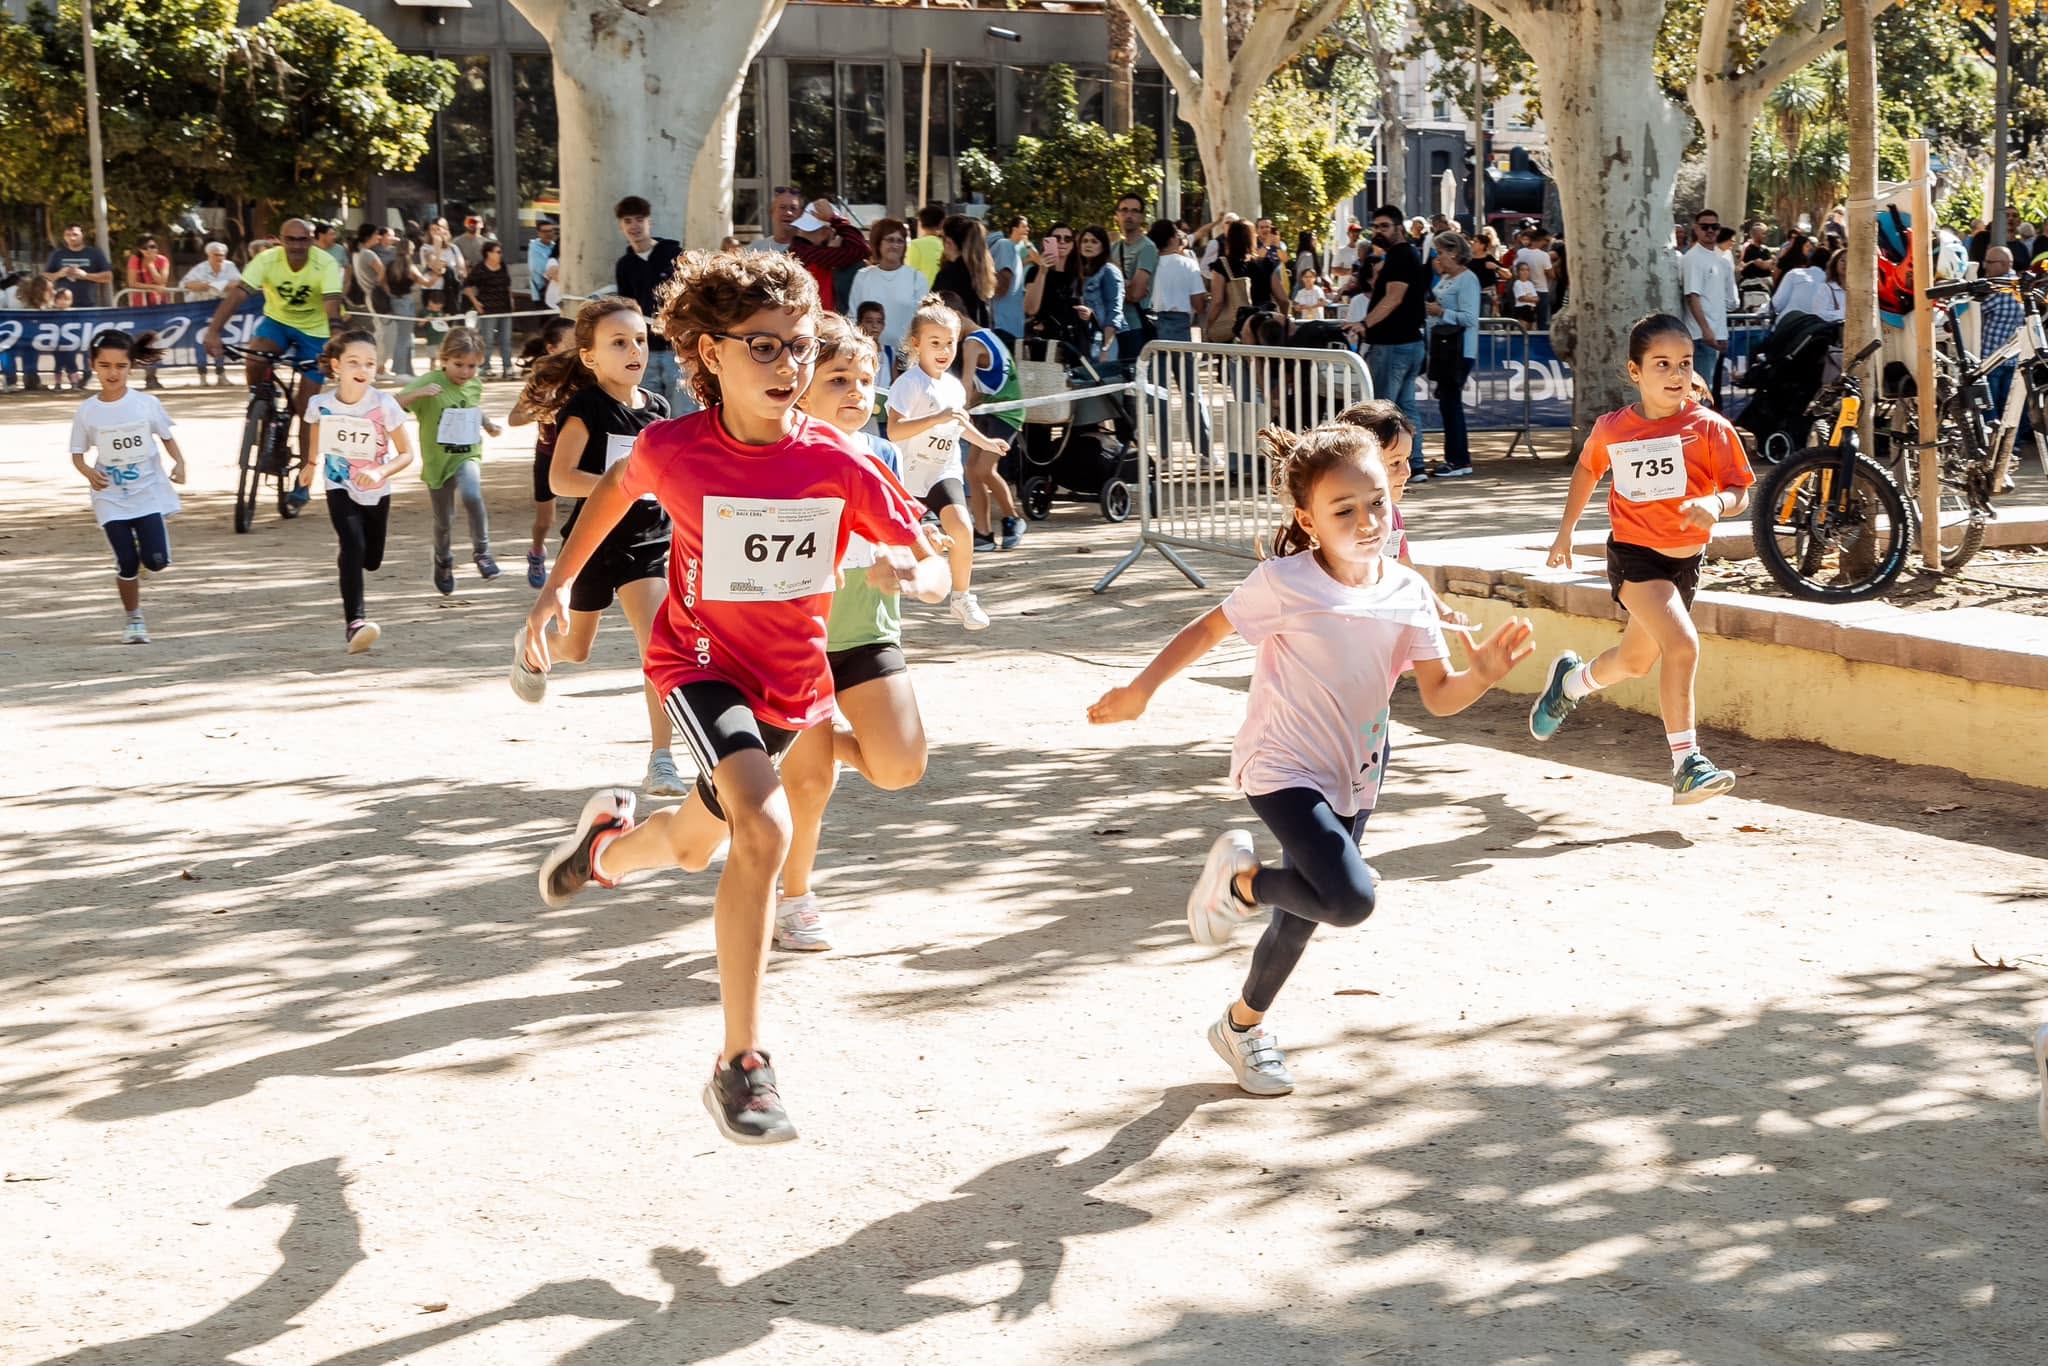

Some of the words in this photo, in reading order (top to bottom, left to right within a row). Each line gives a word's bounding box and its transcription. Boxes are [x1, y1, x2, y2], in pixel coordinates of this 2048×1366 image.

[112, 435, 143, 451] 608
[337, 429, 370, 444] 617
[928, 436, 953, 451] 708
[1630, 457, 1674, 479] 735
[744, 531, 817, 562] 674
[694, 637, 711, 669] ola
